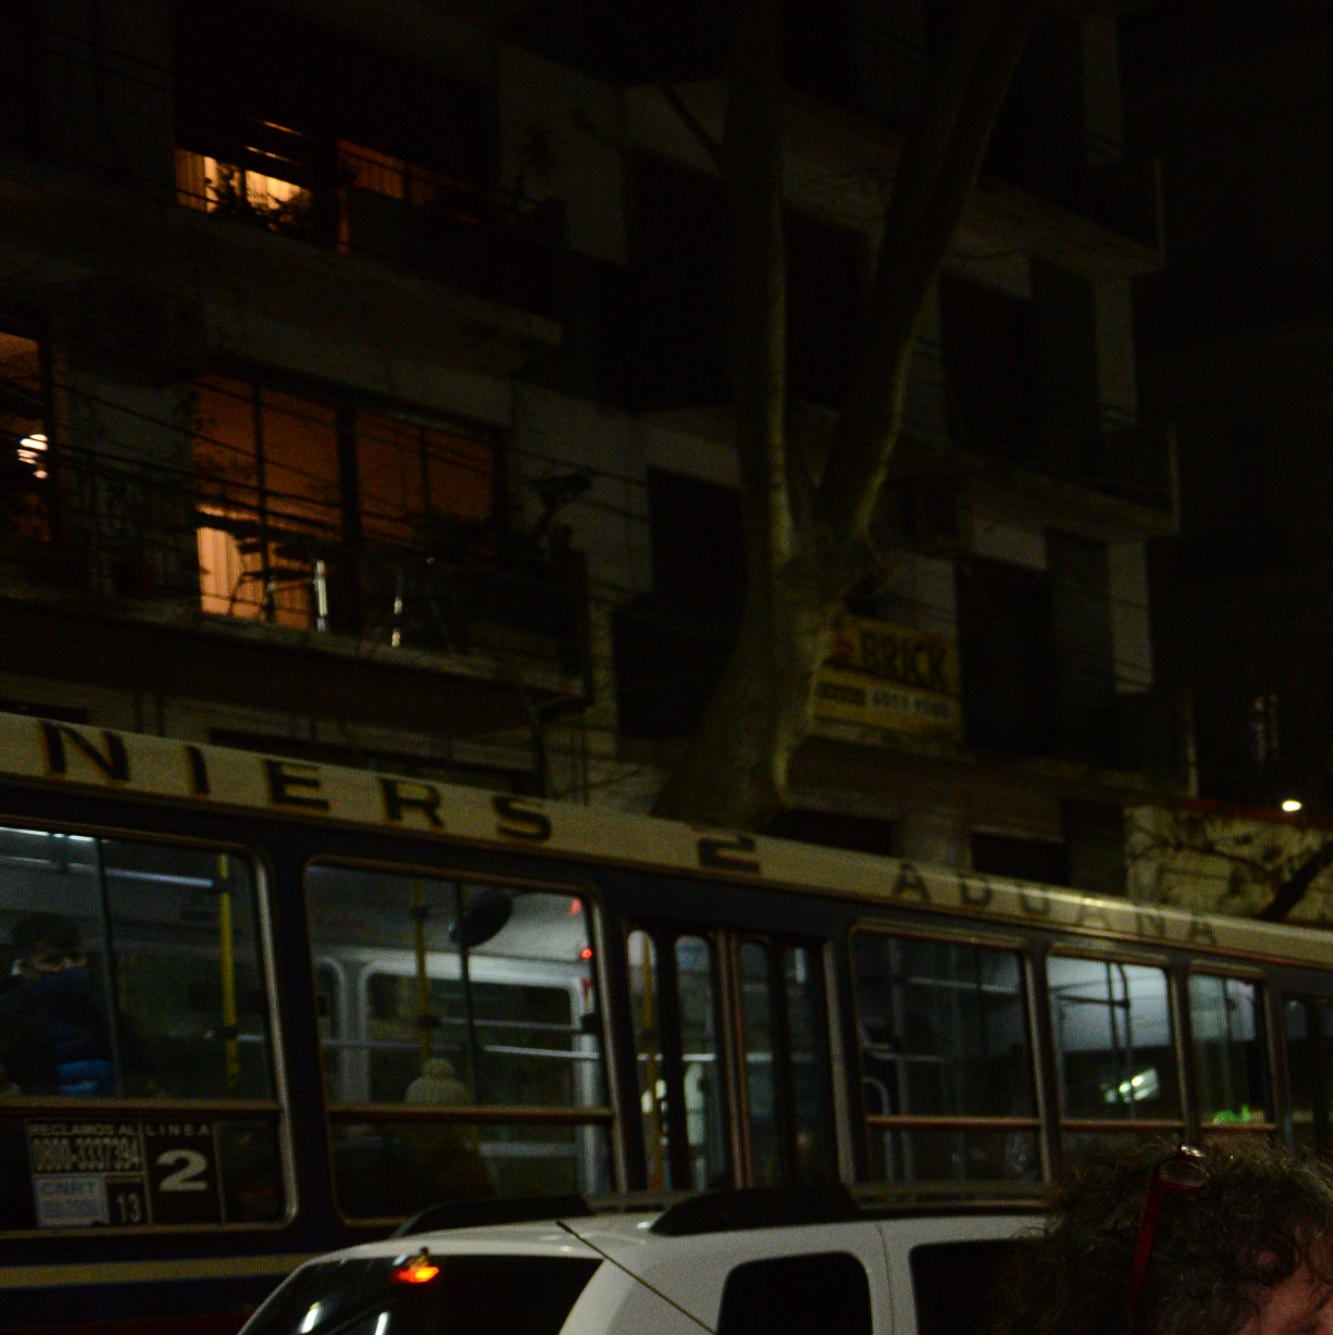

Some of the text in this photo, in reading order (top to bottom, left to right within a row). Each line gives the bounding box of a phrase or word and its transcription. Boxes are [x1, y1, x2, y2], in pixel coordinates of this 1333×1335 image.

[40, 720, 552, 843] NIERS
[894, 864, 1220, 946] ADUANA
[147, 1125, 210, 1136] LINEA
[157, 1149, 209, 1192] 2
[116, 1193, 141, 1223] 13
